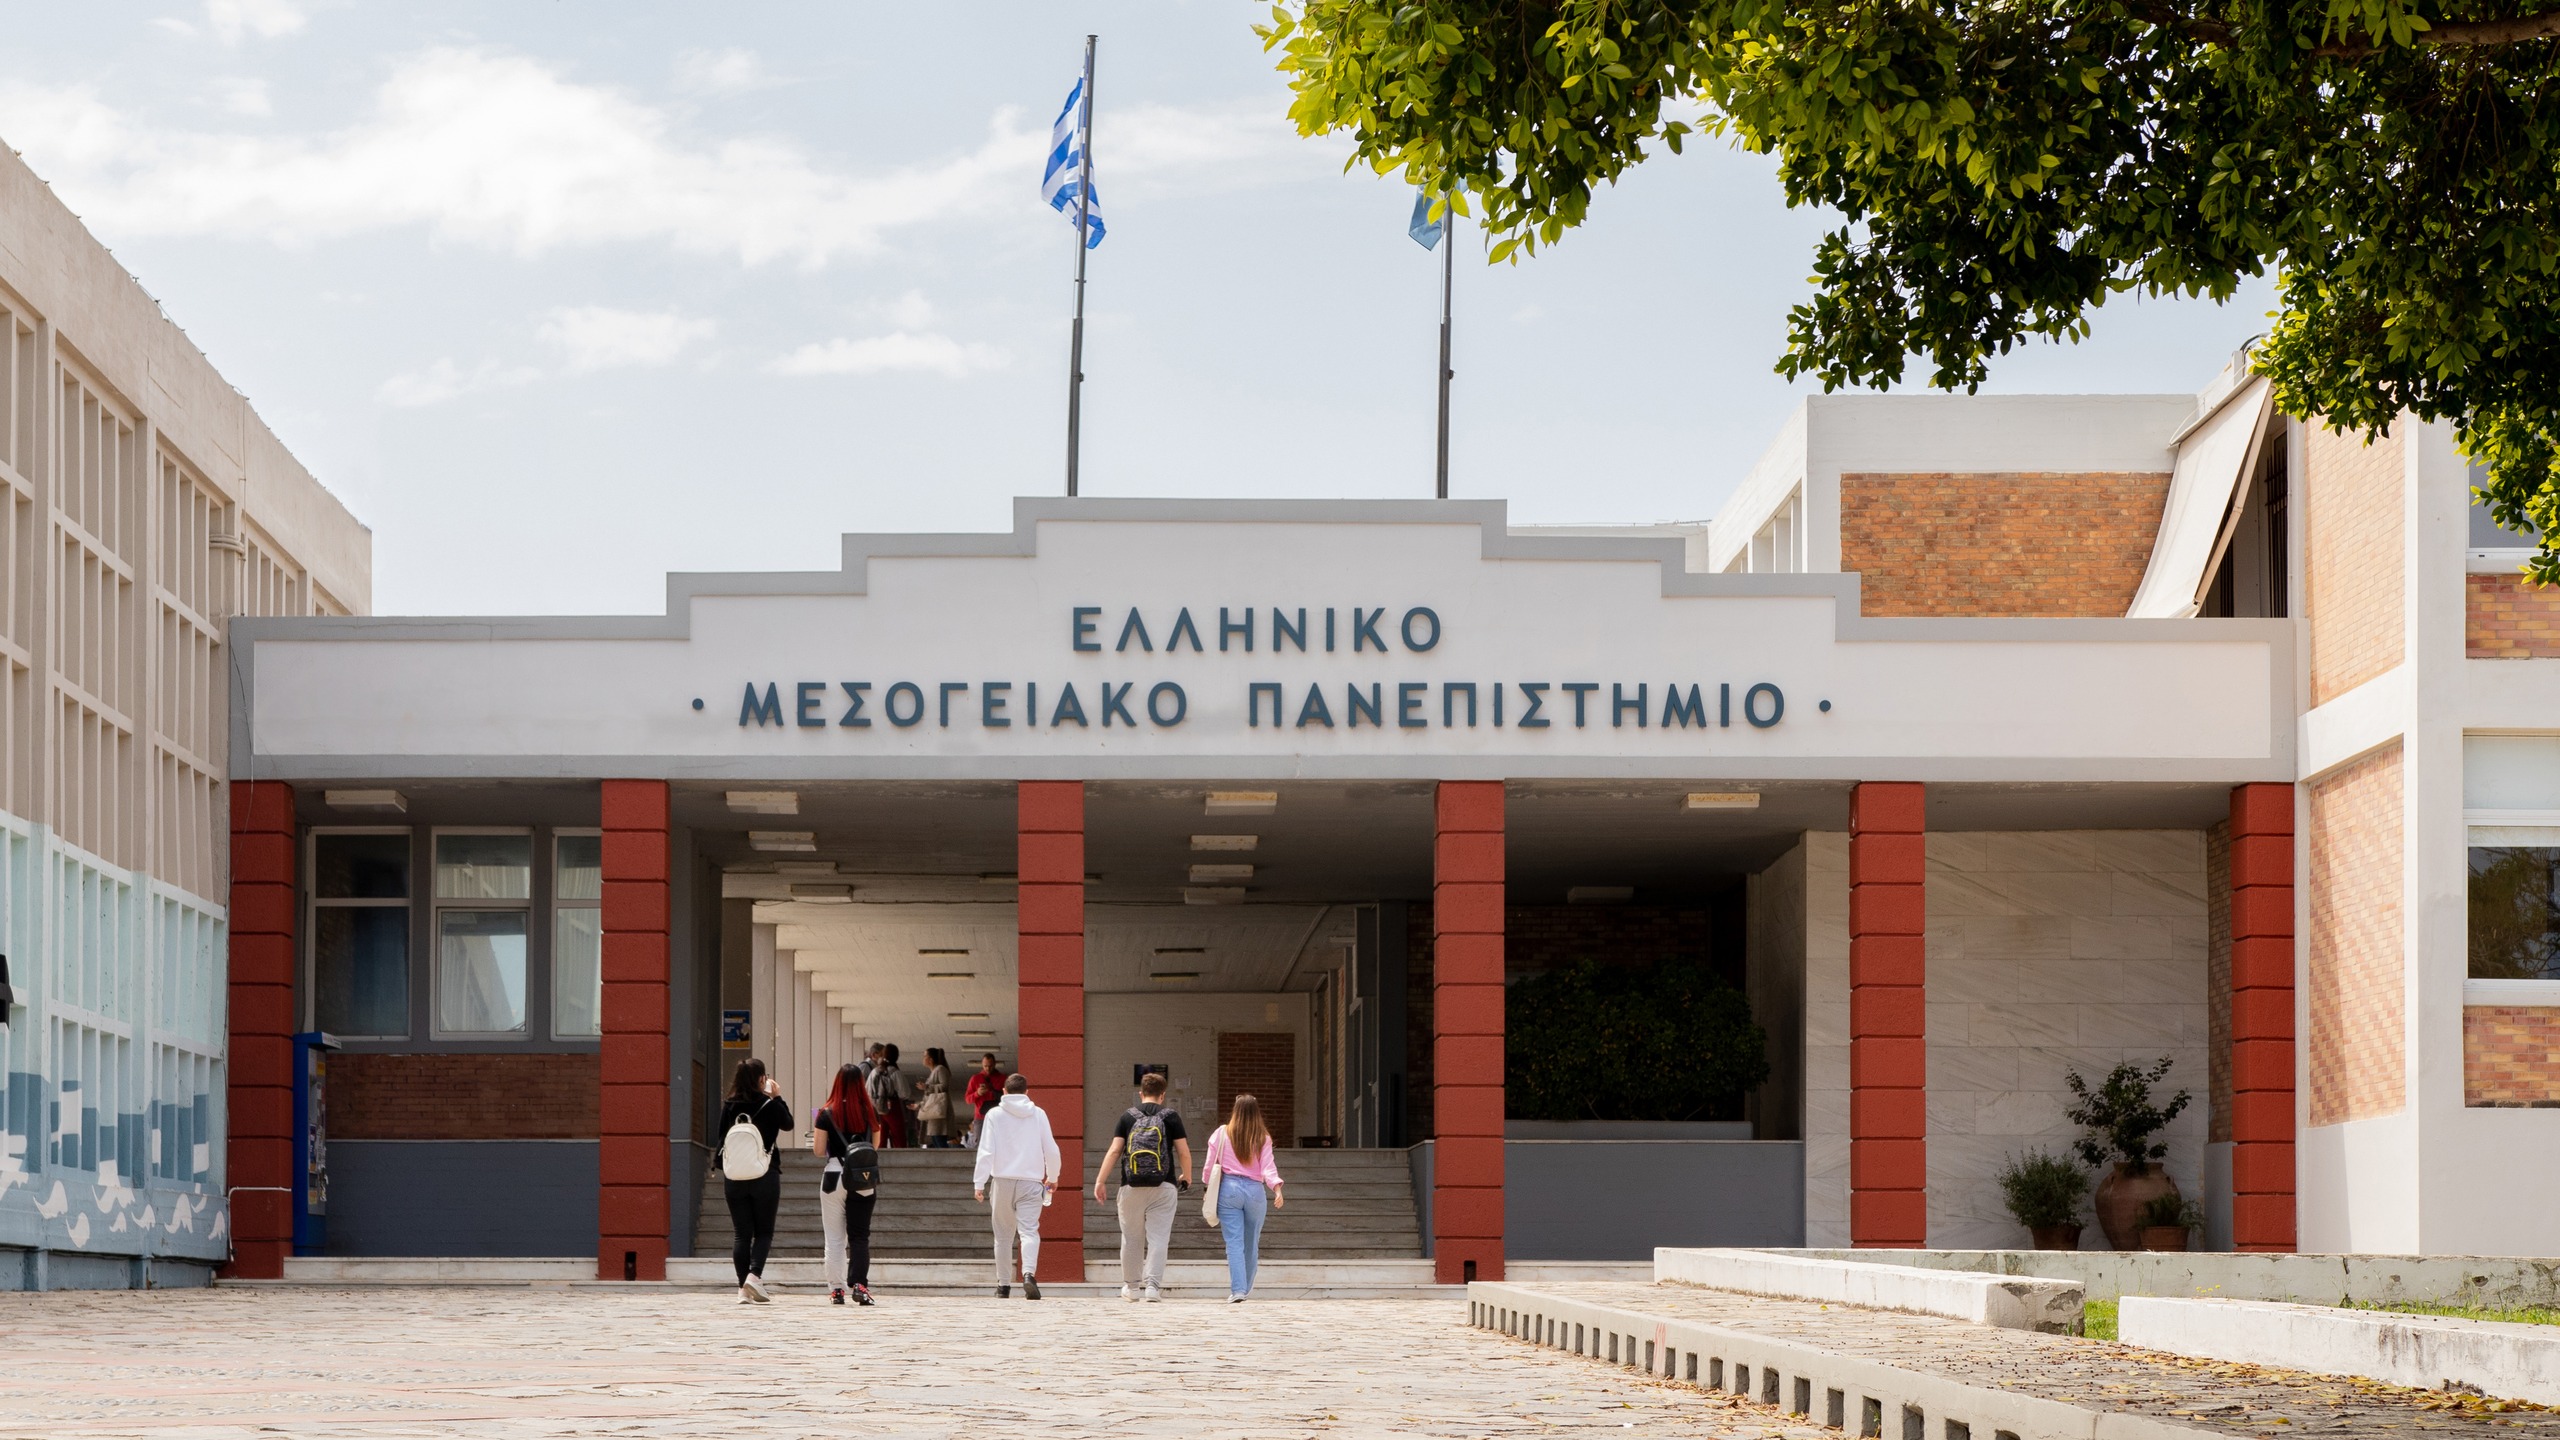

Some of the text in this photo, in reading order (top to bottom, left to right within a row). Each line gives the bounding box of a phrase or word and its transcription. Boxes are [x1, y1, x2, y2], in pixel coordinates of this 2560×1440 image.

[1072, 605, 1442, 654] ΕΛΛΗΝΙΚΟ
[737, 680, 1786, 730] ΜΕΣΟΓΕΙΑΚΟ ΠΑΝΕΠΙΣΤΗΜΙΟ
